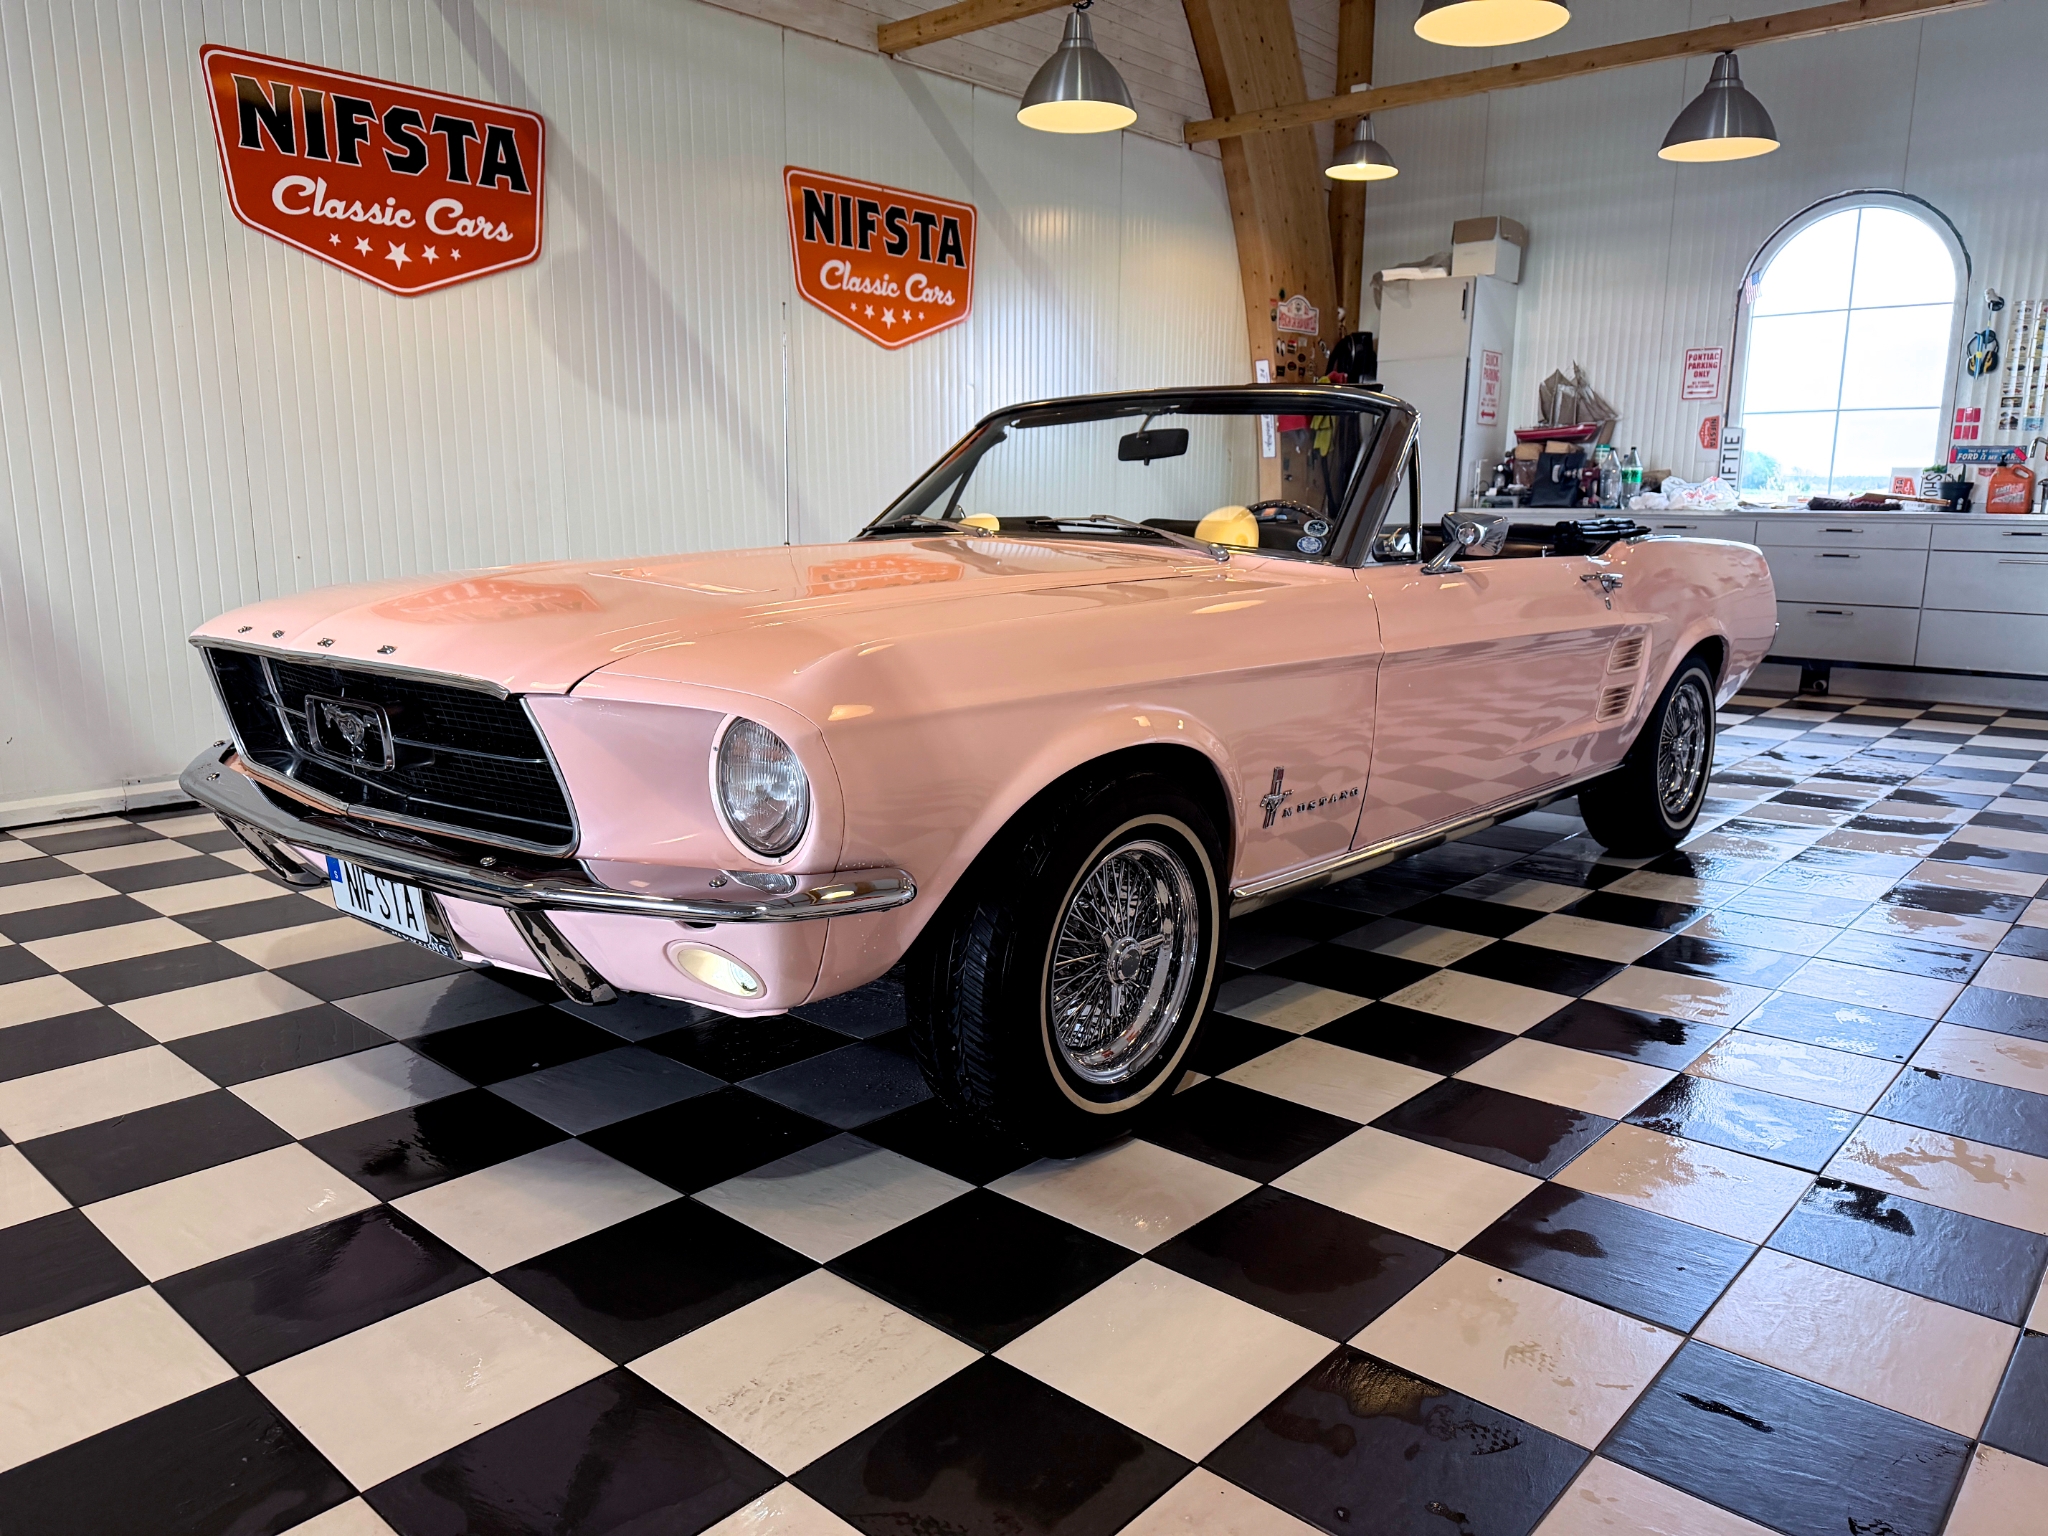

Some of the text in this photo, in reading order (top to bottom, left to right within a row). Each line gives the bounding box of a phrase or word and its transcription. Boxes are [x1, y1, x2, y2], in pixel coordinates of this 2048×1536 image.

[231, 73, 531, 195] NIFSTA
[271, 174, 514, 242] Classic Cars
[801, 186, 967, 269] NIFSTA
[819, 259, 956, 306] Classic Cars
[1688, 352, 1719, 361] PONTIAC
[1688, 361, 1718, 370] PARKING
[1693, 370, 1711, 378] ONLY
[1282, 787, 1359, 818] MUSTANG
[333, 861, 420, 932] S NIFSTA
